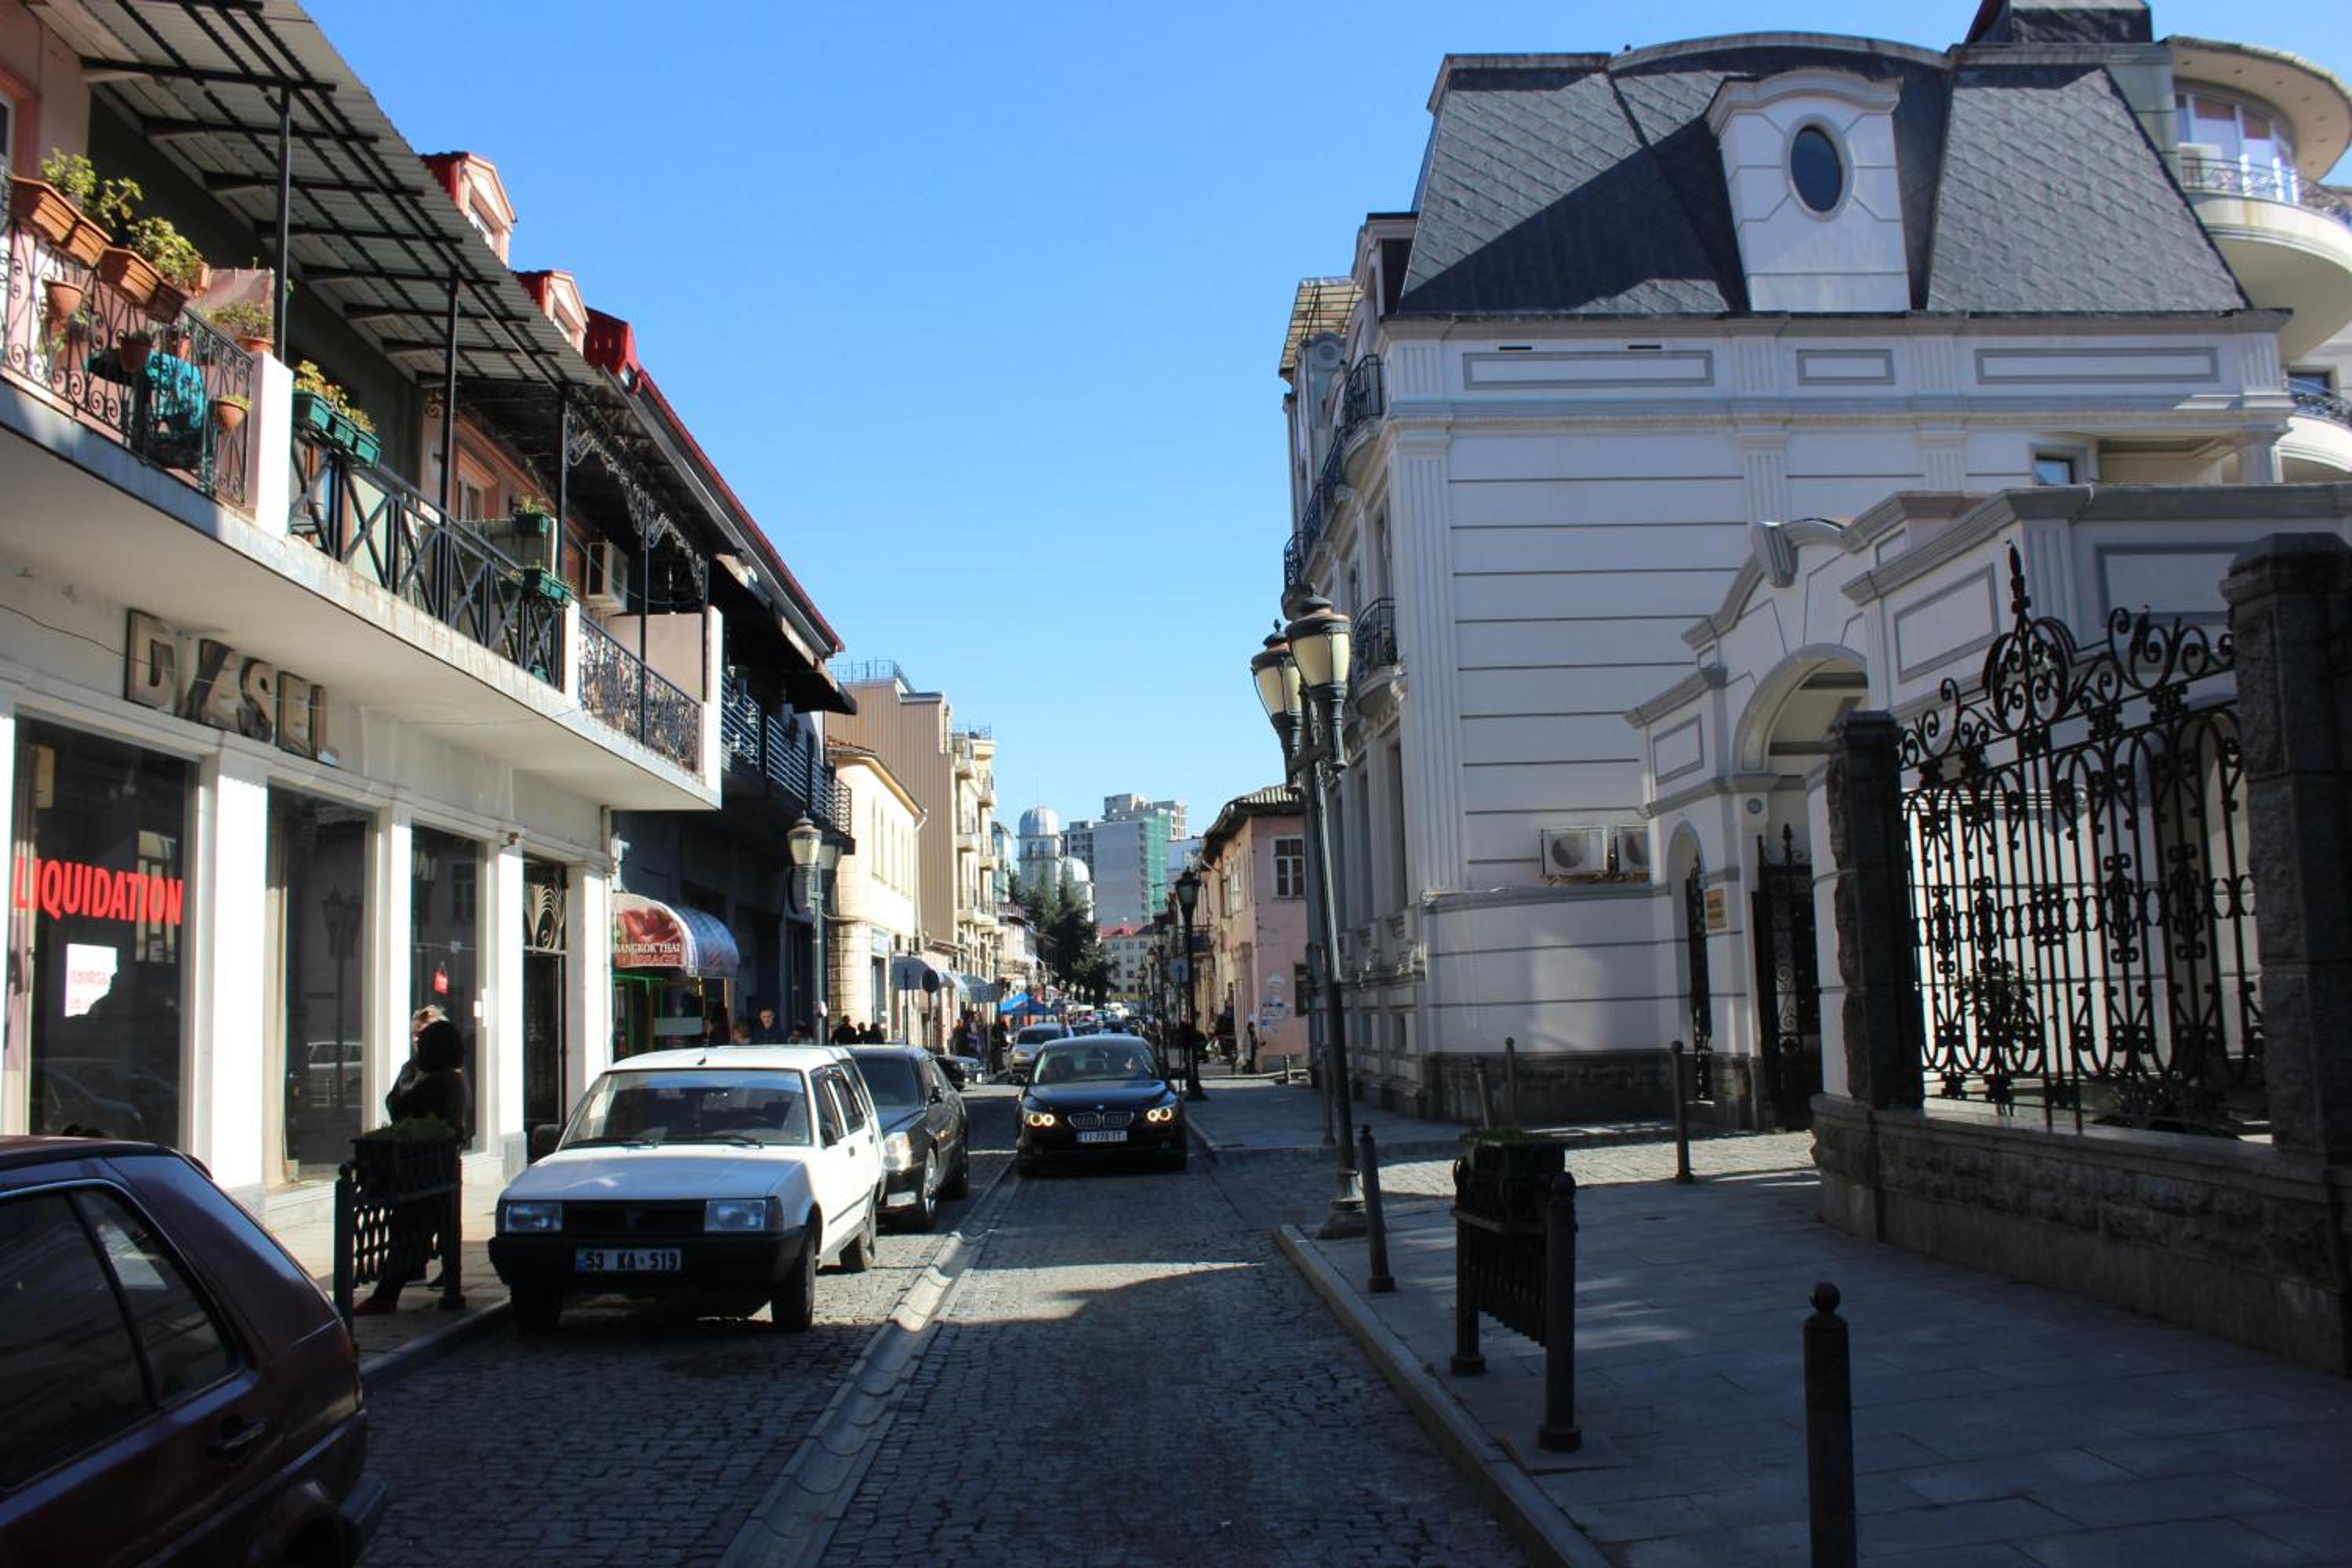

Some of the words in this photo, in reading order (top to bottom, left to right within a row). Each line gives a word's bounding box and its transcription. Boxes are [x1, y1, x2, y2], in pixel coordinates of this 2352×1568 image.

[14, 856, 183, 926] LIQUIDATION
[659, 942, 680, 953] THAI
[586, 1252, 604, 1269] 53
[616, 1252, 636, 1269] KA
